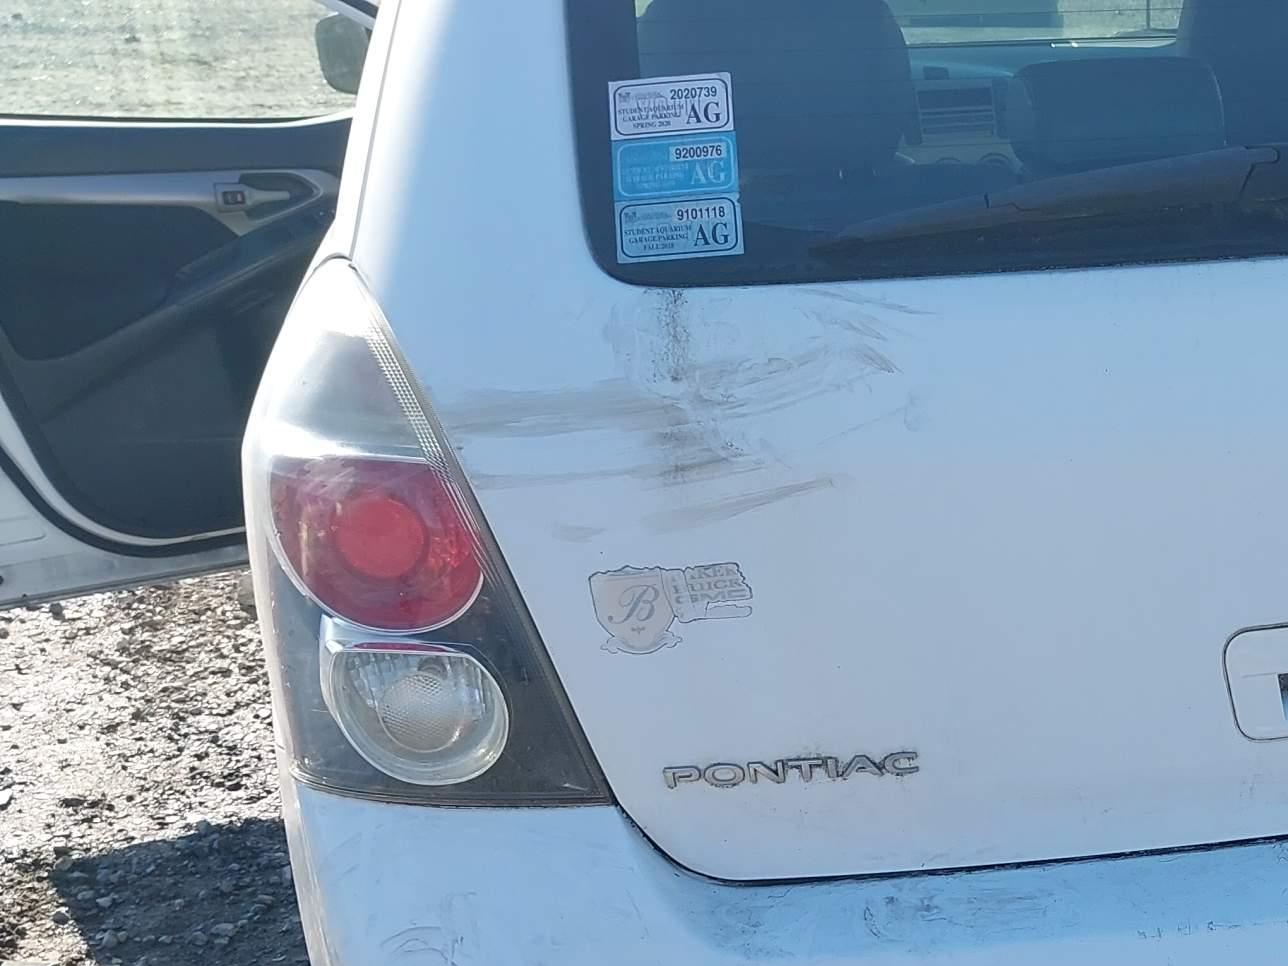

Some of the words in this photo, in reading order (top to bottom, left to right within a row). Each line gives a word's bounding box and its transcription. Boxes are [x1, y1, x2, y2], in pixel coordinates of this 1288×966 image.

[669, 86, 717, 101] 2020739
[686, 101, 721, 125] AG
[674, 144, 722, 160] 9200976
[691, 161, 726, 185] AG
[677, 206, 725, 221] 9101118
[694, 222, 729, 247] AG
[662, 752, 919, 788] PONTIAC
